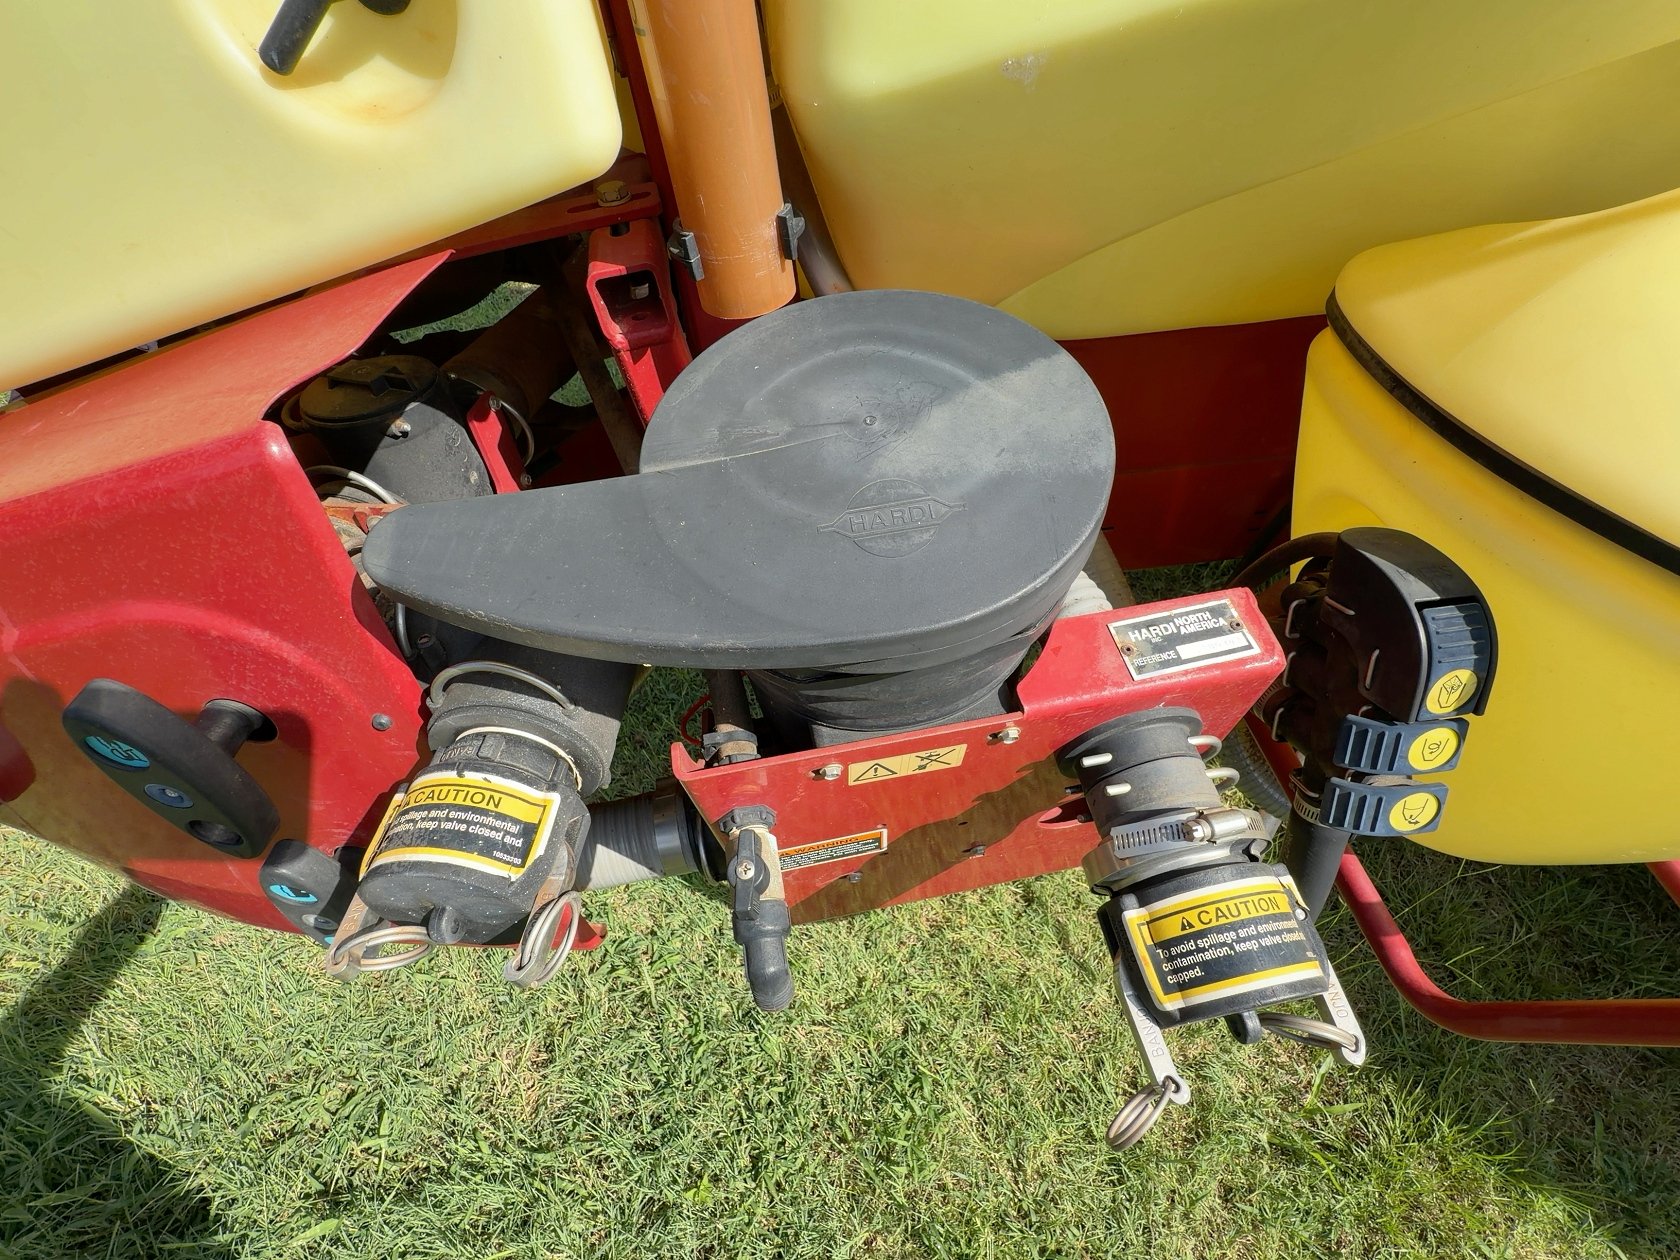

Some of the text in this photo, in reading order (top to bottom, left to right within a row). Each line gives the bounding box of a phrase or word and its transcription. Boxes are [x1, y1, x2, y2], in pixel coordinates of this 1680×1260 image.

[850, 504, 936, 532] HARDI
[1128, 611, 1212, 642] HARDI NORTH
[1179, 617, 1228, 635] AMERICA
[1134, 650, 1177, 666] REFERENCE
[414, 788, 502, 808] CAUTION
[416, 820, 438, 830] keep
[440, 821, 467, 831] valve
[468, 825, 503, 840] closed
[503, 835, 523, 847] and
[428, 809, 449, 818] and
[449, 811, 520, 834] environmental
[1197, 896, 1280, 925] CAUTION
[1156, 949, 1169, 959] To
[1170, 940, 1196, 956] avoid
[1197, 931, 1237, 949] spillage
[1238, 924, 1257, 938] and
[1162, 946, 1235, 971] contamination,
[1233, 940, 1258, 953] keep
[1259, 934, 1282, 946] valve
[1167, 966, 1205, 984] capped.
[1136, 1007, 1164, 1058] BANJO
